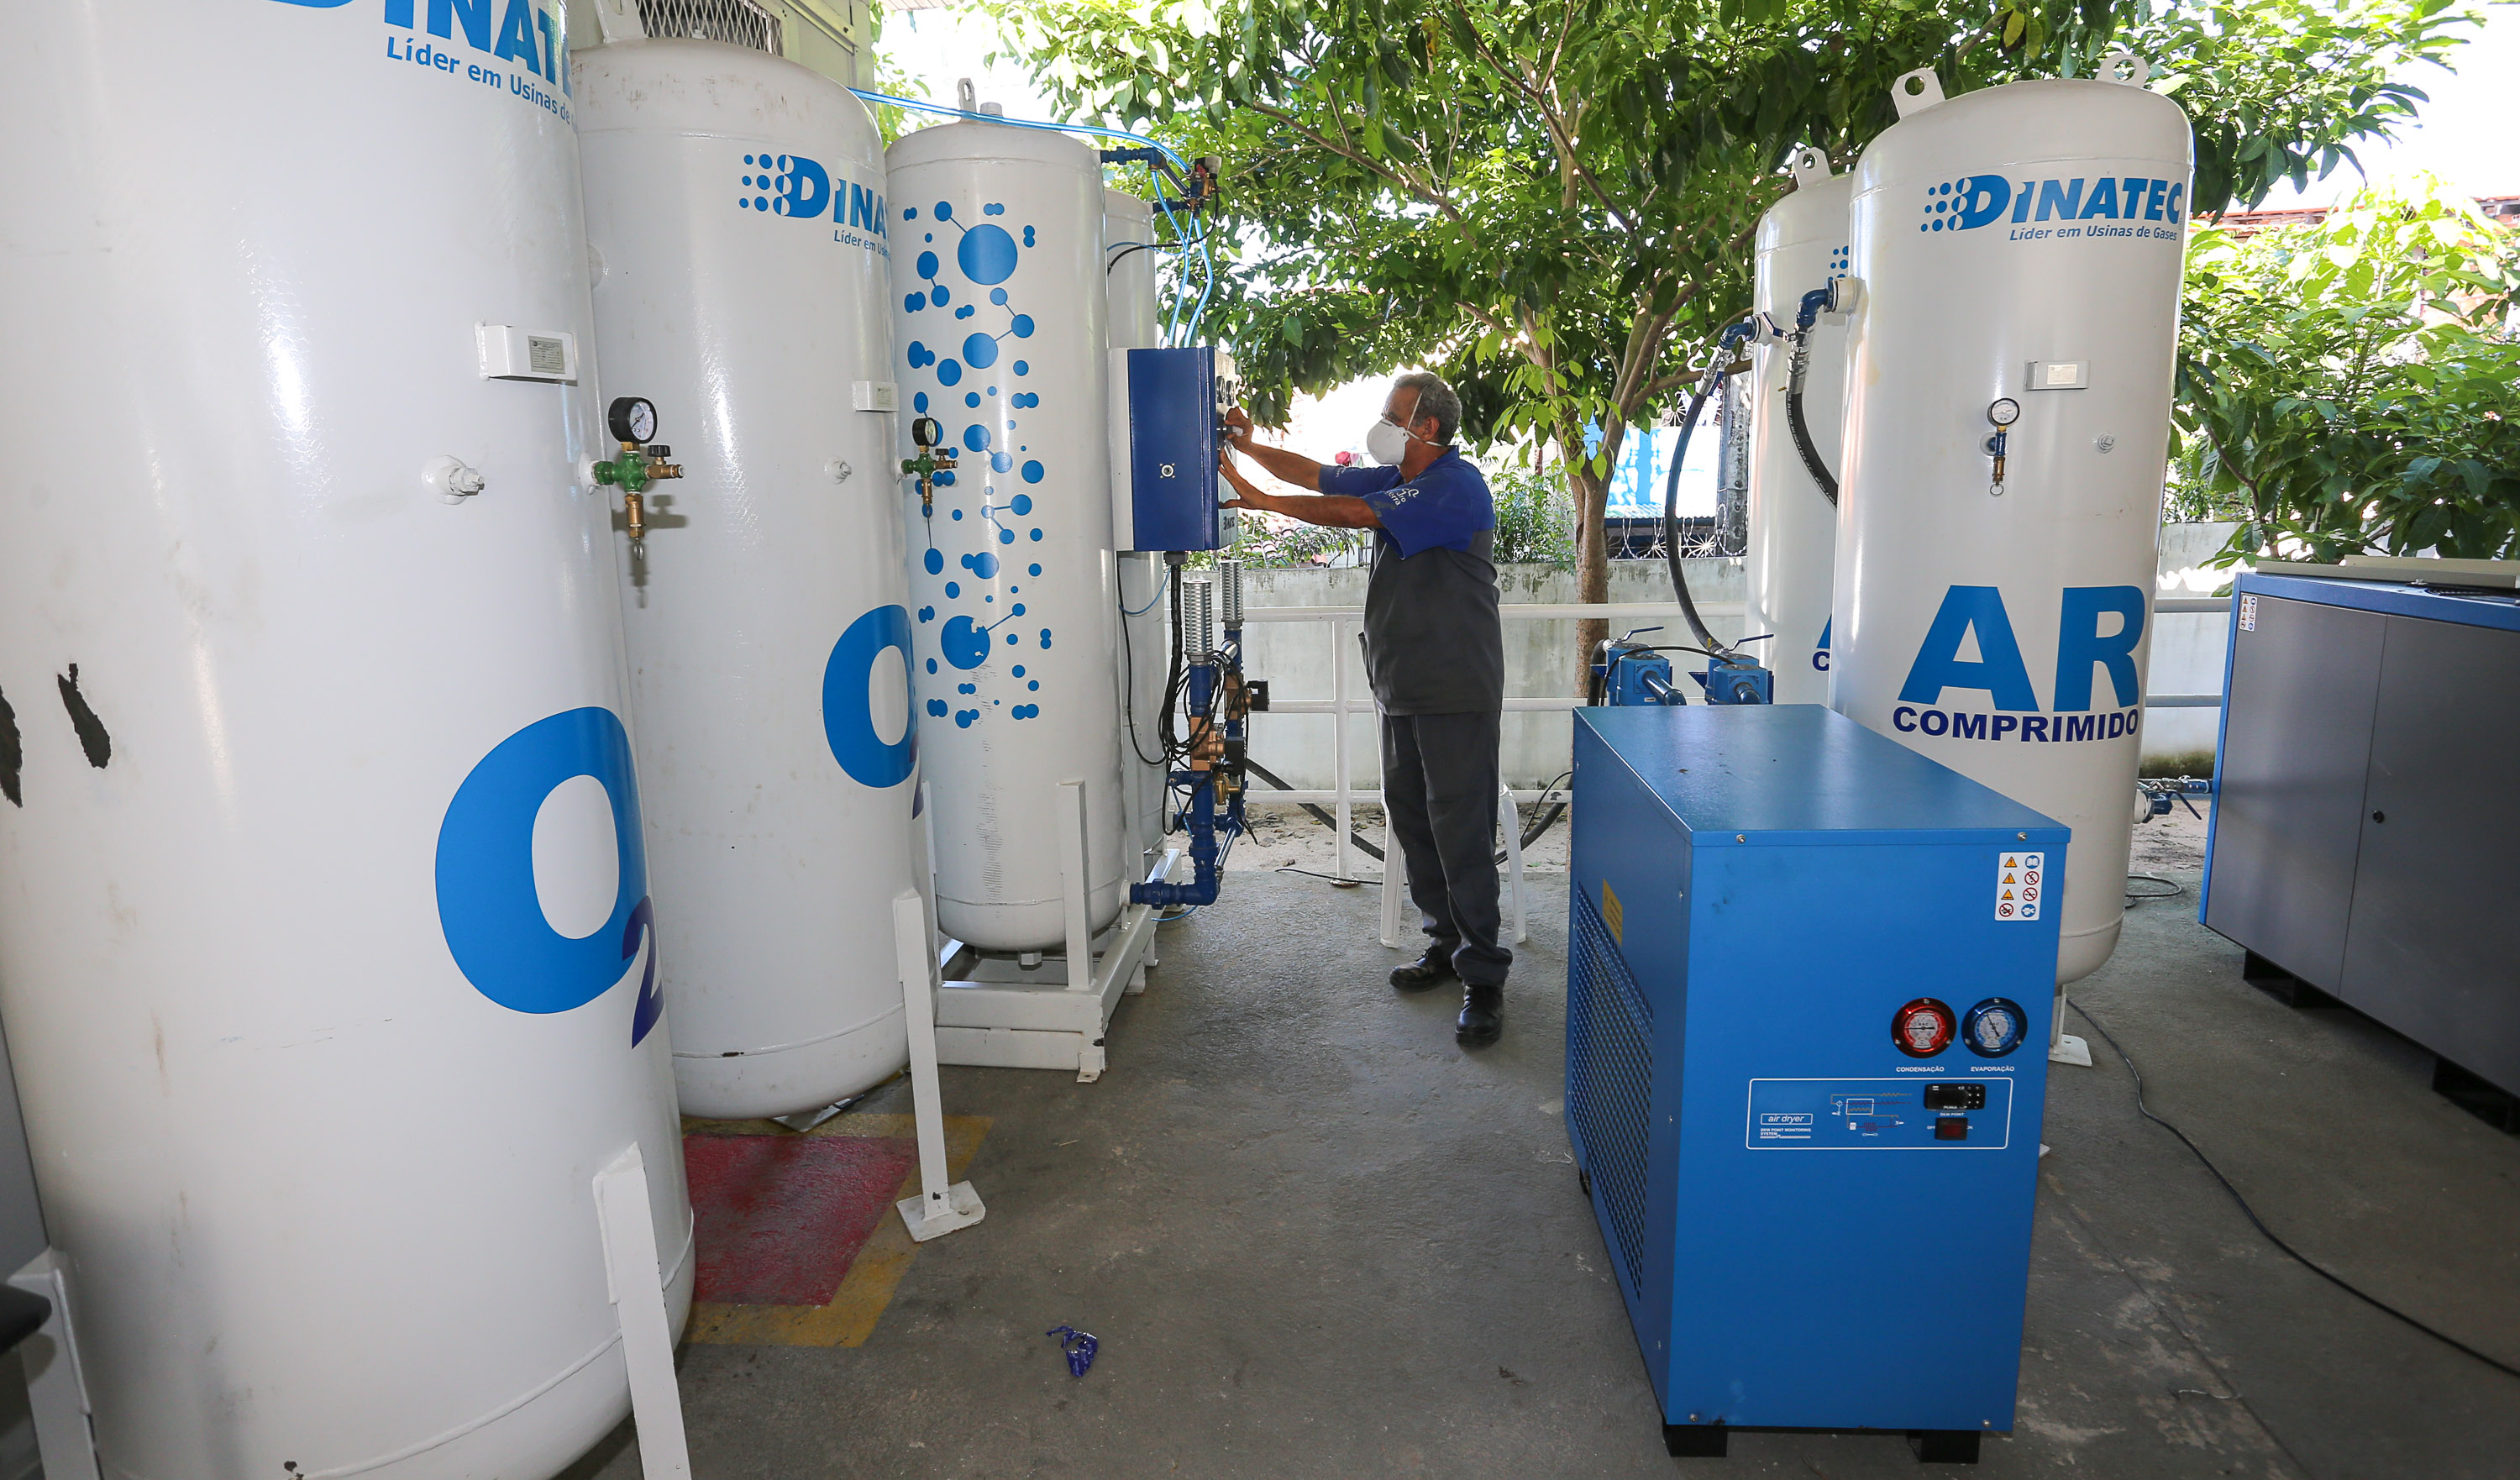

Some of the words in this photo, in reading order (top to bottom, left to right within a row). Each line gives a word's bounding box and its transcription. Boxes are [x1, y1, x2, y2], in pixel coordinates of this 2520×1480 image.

[387, 36, 459, 73] Líder
[468, 64, 501, 89] em
[510, 74, 558, 115] Usinas
[560, 102, 570, 125] de
[773, 155, 887, 240] DINA
[1947, 175, 2182, 232] DINATEC
[834, 230, 862, 247] Líder
[864, 239, 875, 252] em
[2009, 228, 2051, 240] Líder
[2056, 226, 2081, 238] em
[2087, 225, 2133, 237] Usinas
[2136, 225, 2150, 237] de
[2153, 227, 2177, 241] Gases
[1898, 585, 2145, 712] AR
[1893, 706, 2139, 743] COMPRIMIDO
[1781, 1115, 1804, 1124] dryer
